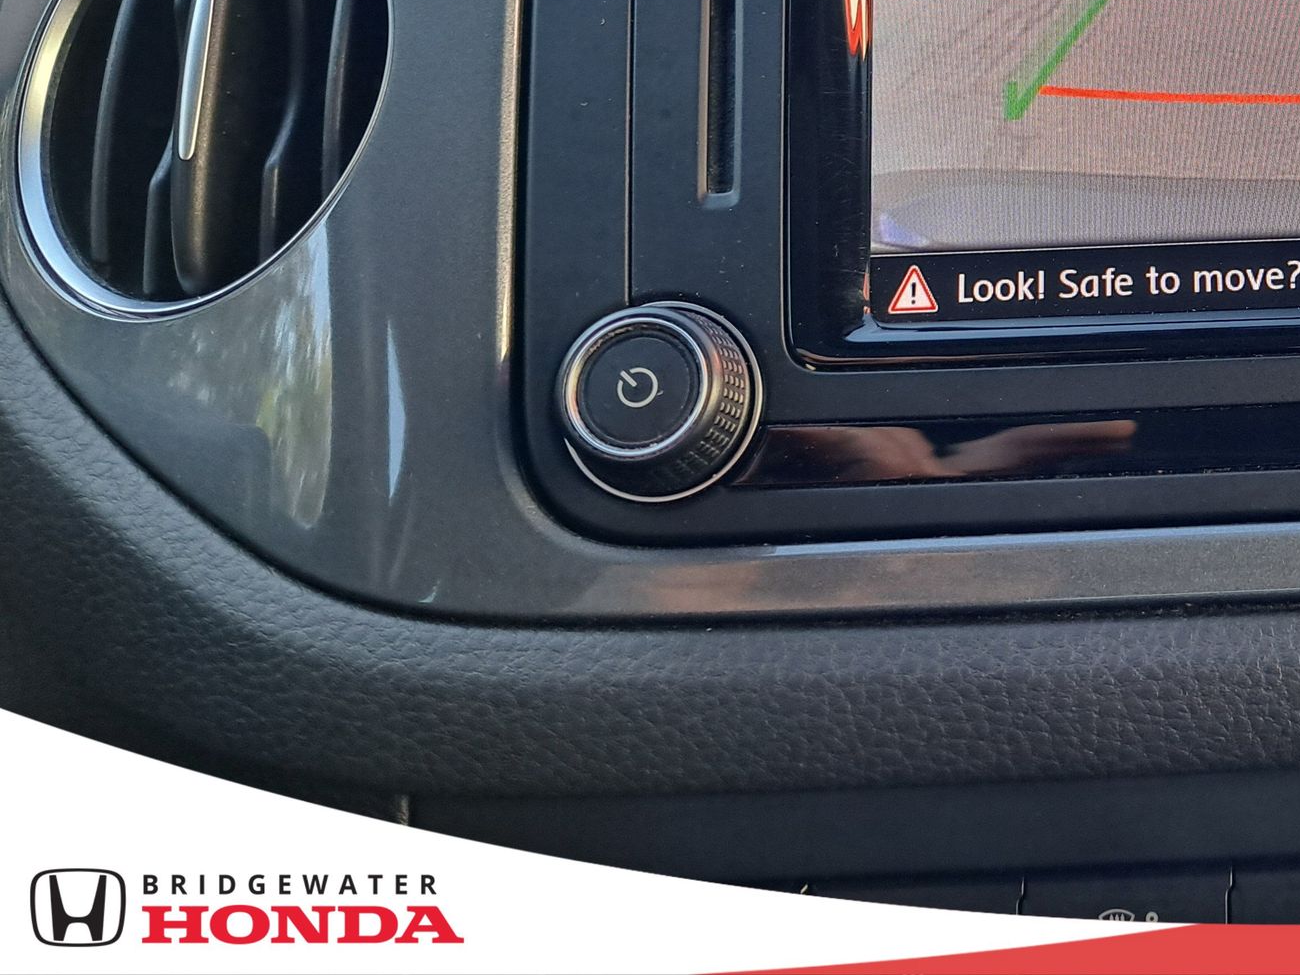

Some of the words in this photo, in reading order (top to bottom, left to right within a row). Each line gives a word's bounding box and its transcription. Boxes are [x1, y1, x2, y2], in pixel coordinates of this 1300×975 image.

[957, 269, 1046, 304] Look!
[1058, 266, 1134, 300] Safe
[1145, 266, 1181, 295] to
